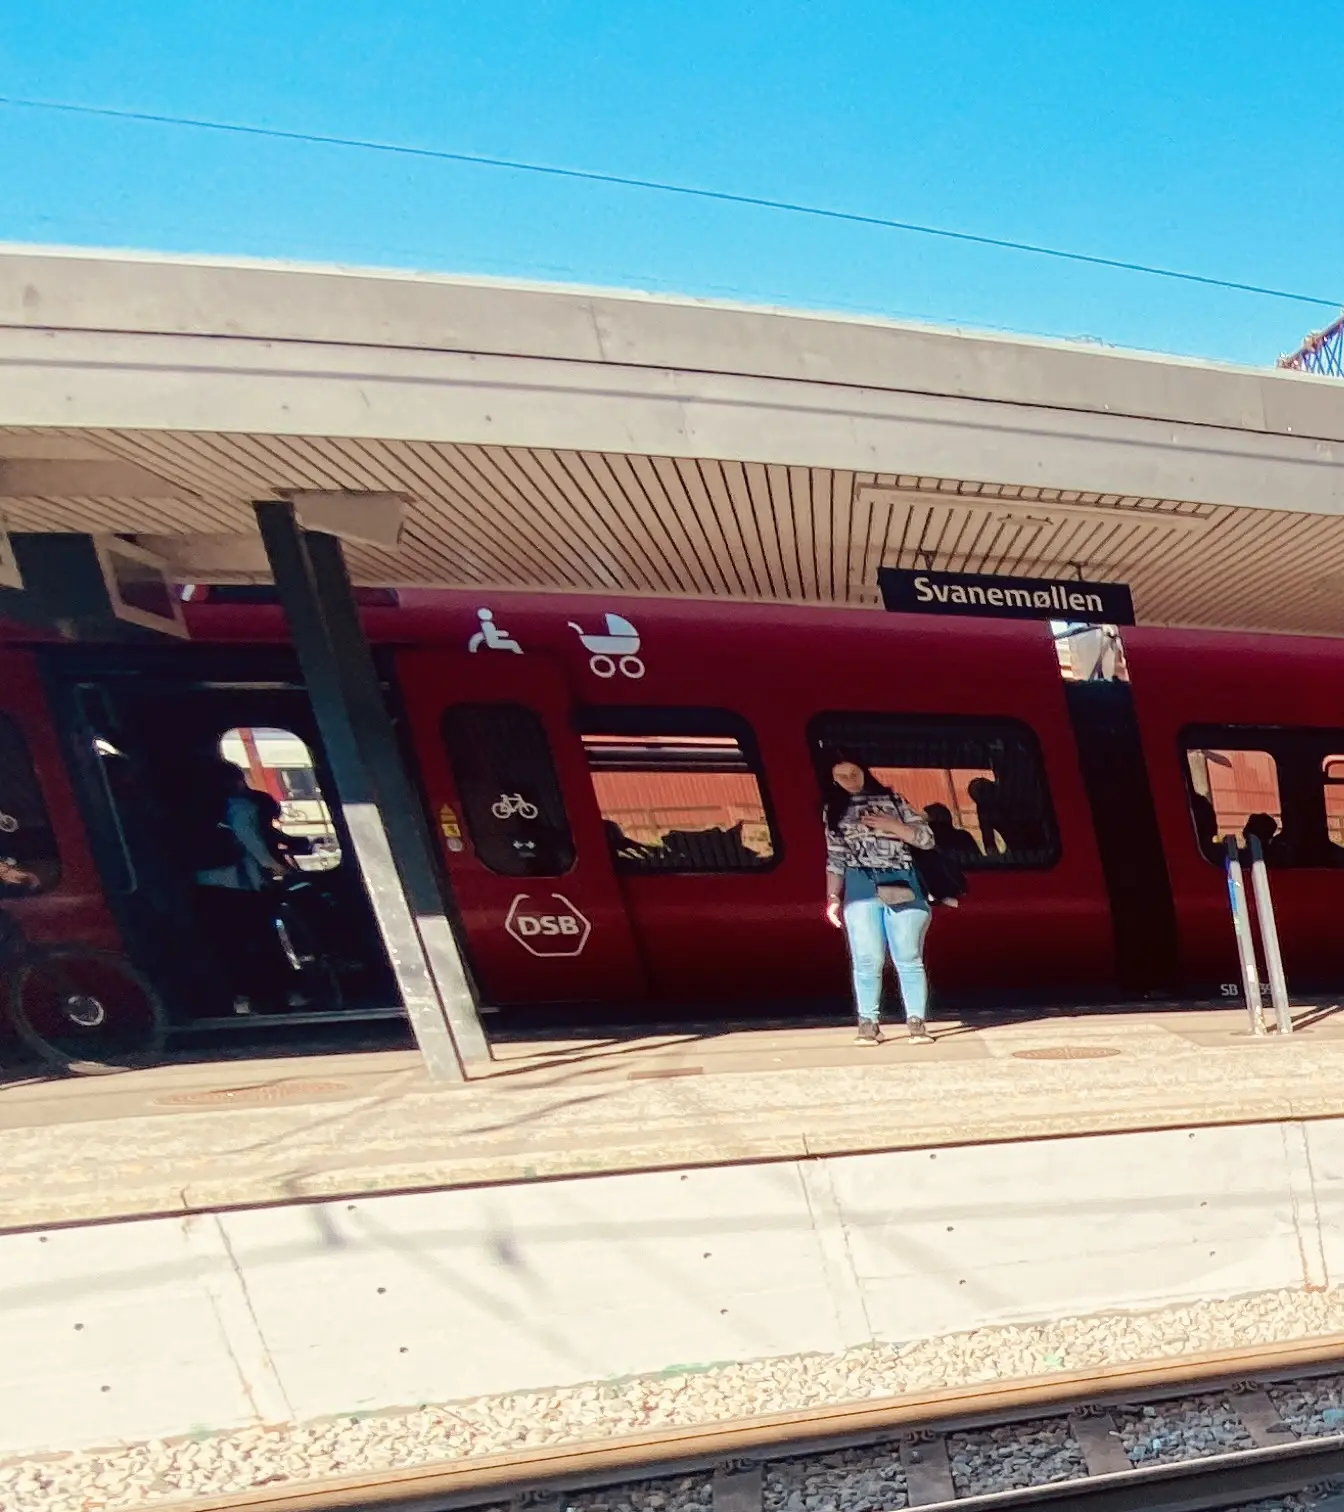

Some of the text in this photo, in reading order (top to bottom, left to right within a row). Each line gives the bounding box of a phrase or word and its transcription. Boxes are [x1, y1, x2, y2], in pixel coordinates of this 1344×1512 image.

[913, 577, 1103, 612] Svanemøllen
[516, 915, 580, 936] DSB
[1220, 983, 1239, 997] SB
